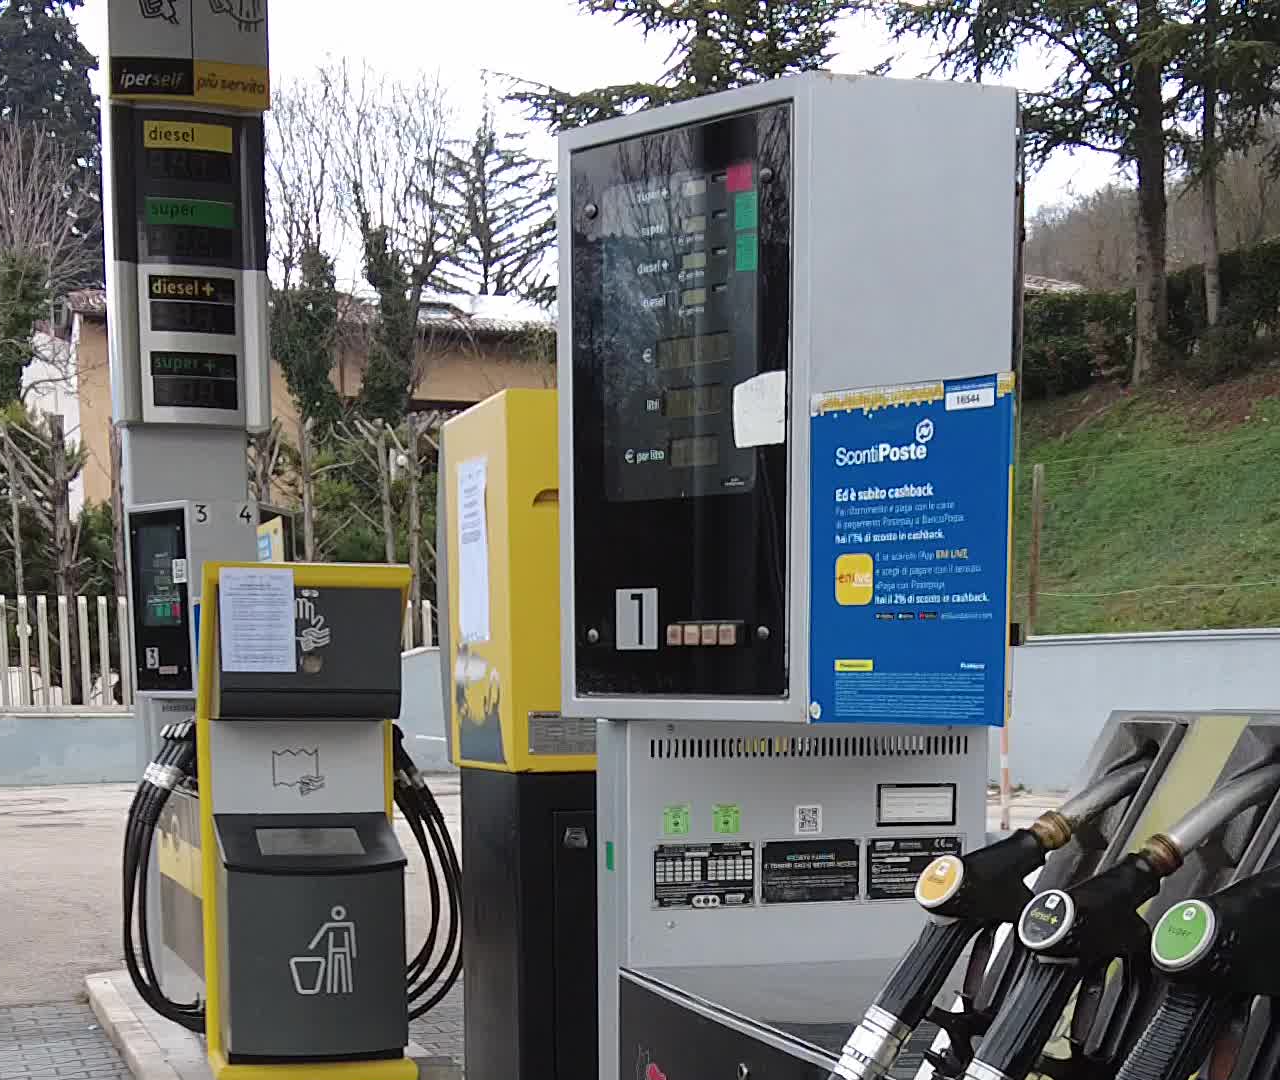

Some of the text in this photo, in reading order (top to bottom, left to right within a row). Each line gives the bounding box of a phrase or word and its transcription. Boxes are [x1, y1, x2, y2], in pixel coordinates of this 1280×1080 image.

[120, 67, 184, 88] iperself
[149, 126, 194, 142] diesel
[151, 204, 195, 218] super
[152, 280, 198, 295] diesel
[642, 348, 652, 363] €
[155, 357, 198, 371] super
[625, 449, 635, 464] €
[836, 443, 927, 466] ScontiPoste
[835, 488, 849, 502] Ed
[858, 486, 887, 500] subito
[888, 483, 934, 498] cashback
[196, 505, 251, 524] 3 4
[631, 593, 644, 645] 1
[149, 649, 156, 666] 3
